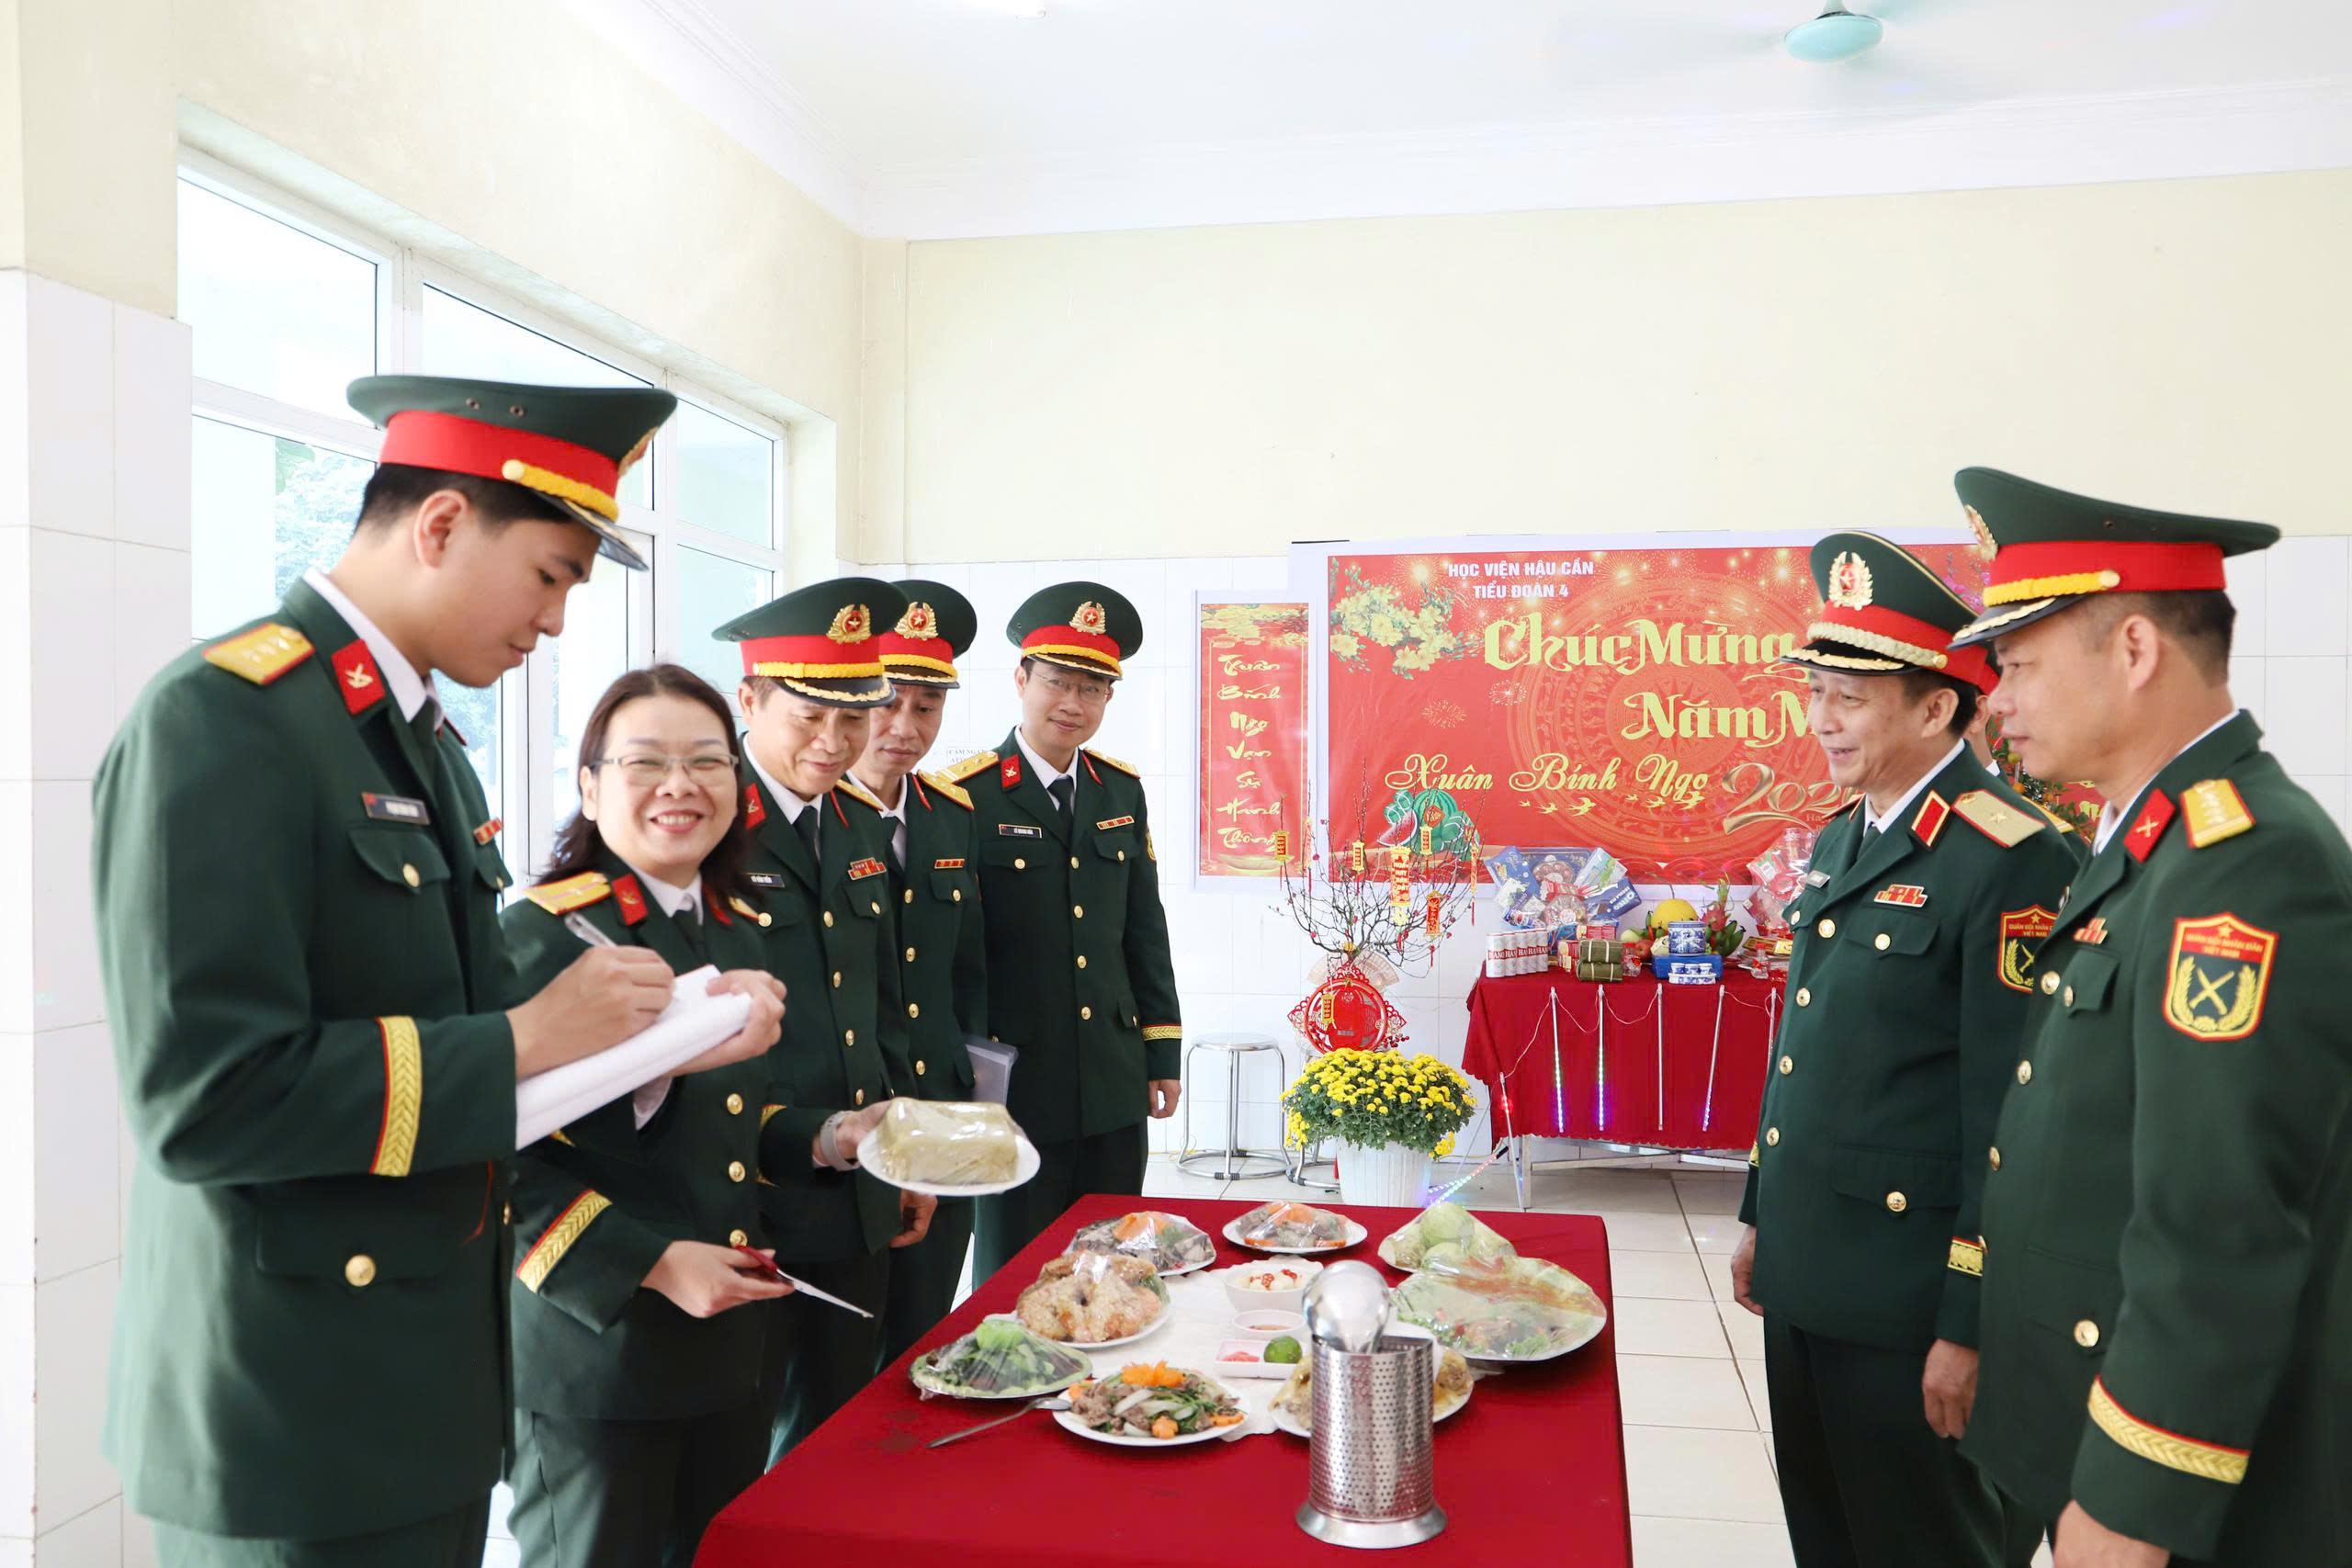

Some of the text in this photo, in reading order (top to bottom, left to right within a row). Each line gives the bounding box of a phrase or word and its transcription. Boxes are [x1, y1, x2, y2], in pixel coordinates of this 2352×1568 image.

[1448, 562, 1480, 581] HỌC
[1484, 559, 1521, 580] VIỆN
[1524, 558, 1556, 579] HẬU
[1474, 580, 1569, 599] TIỂU ĐOÀN 4
[1484, 612, 1809, 683] Chúc Mừng
[1621, 691, 1775, 741] Năm
[1385, 752, 1494, 791] Xuân
[1508, 752, 1622, 793] Bính
[1721, 761, 1856, 836] 202
